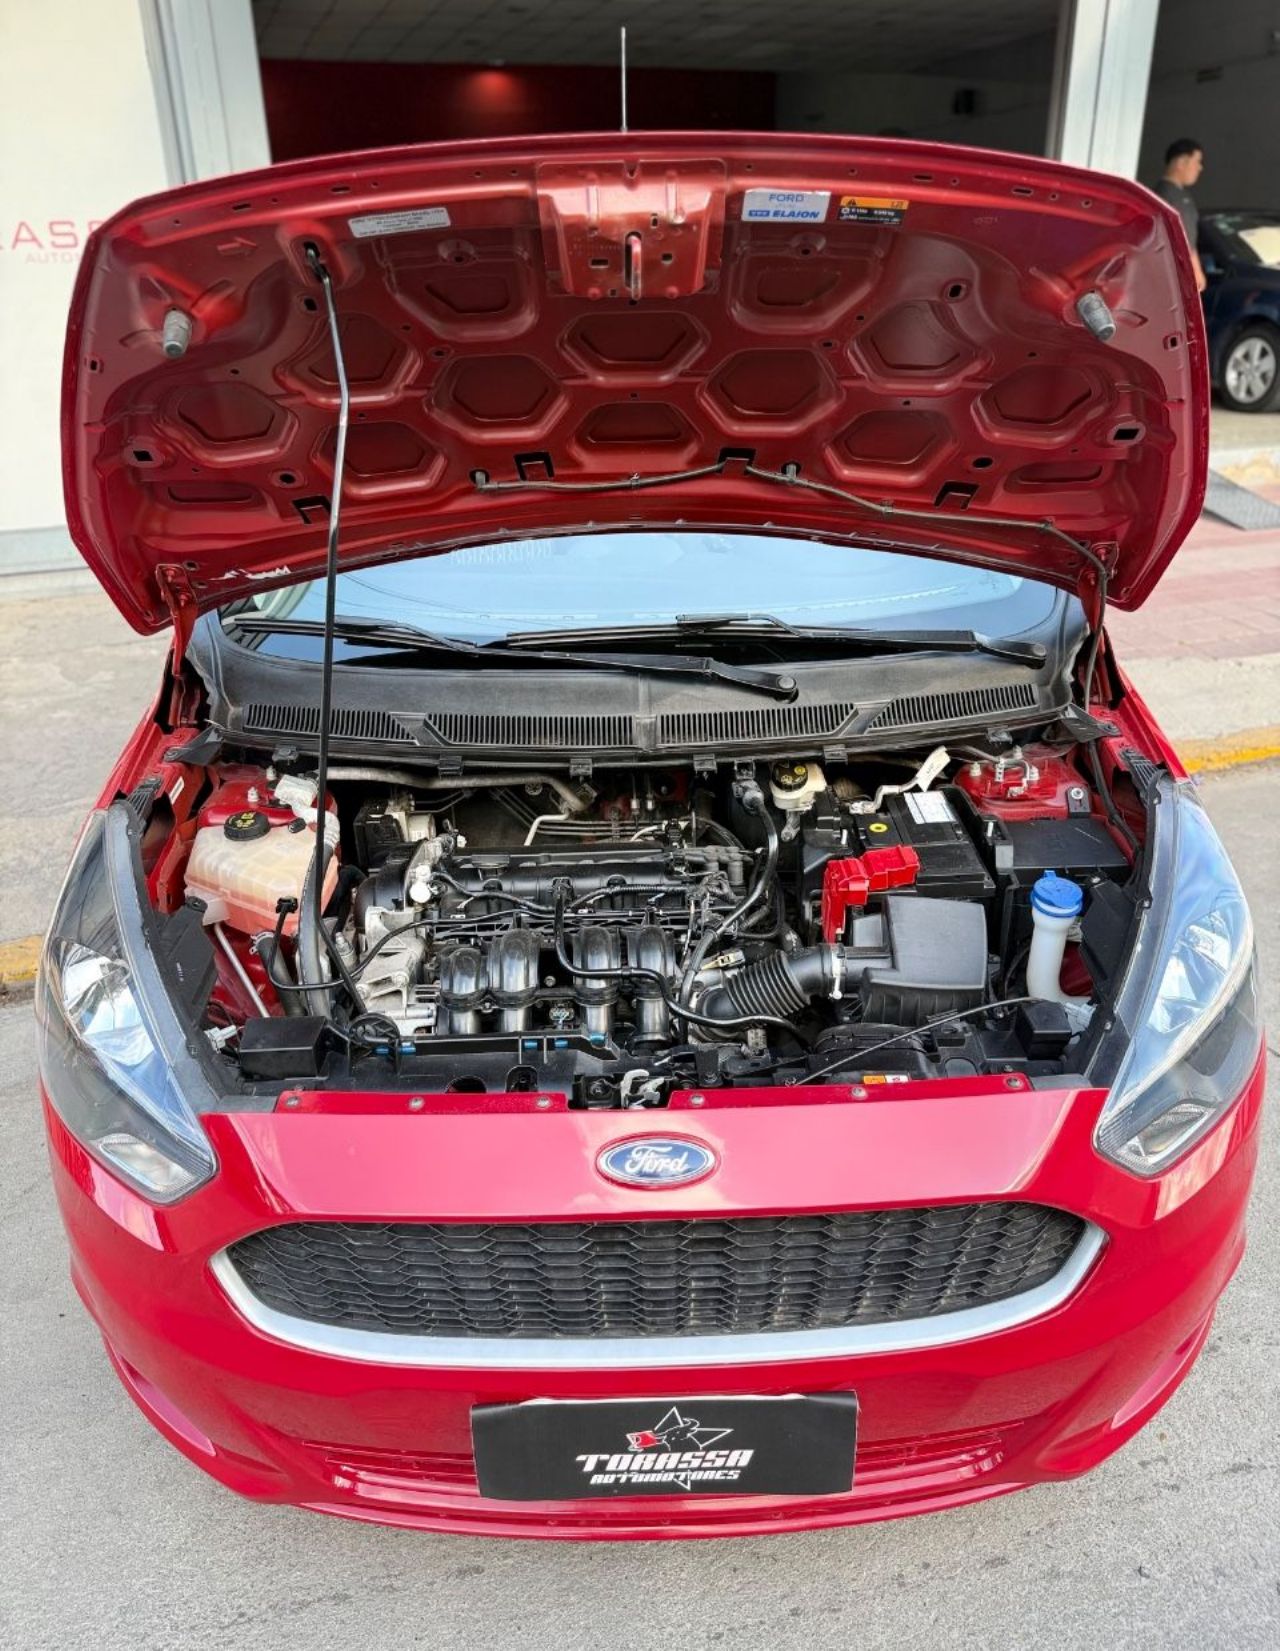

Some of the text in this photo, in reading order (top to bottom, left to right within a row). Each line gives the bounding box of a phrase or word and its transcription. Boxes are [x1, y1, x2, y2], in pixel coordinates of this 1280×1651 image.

[768, 193, 804, 202] FORD
[772, 210, 820, 218] ELAION
[624, 1145, 690, 1174] Ford
[575, 1449, 754, 1472] TORASSA
